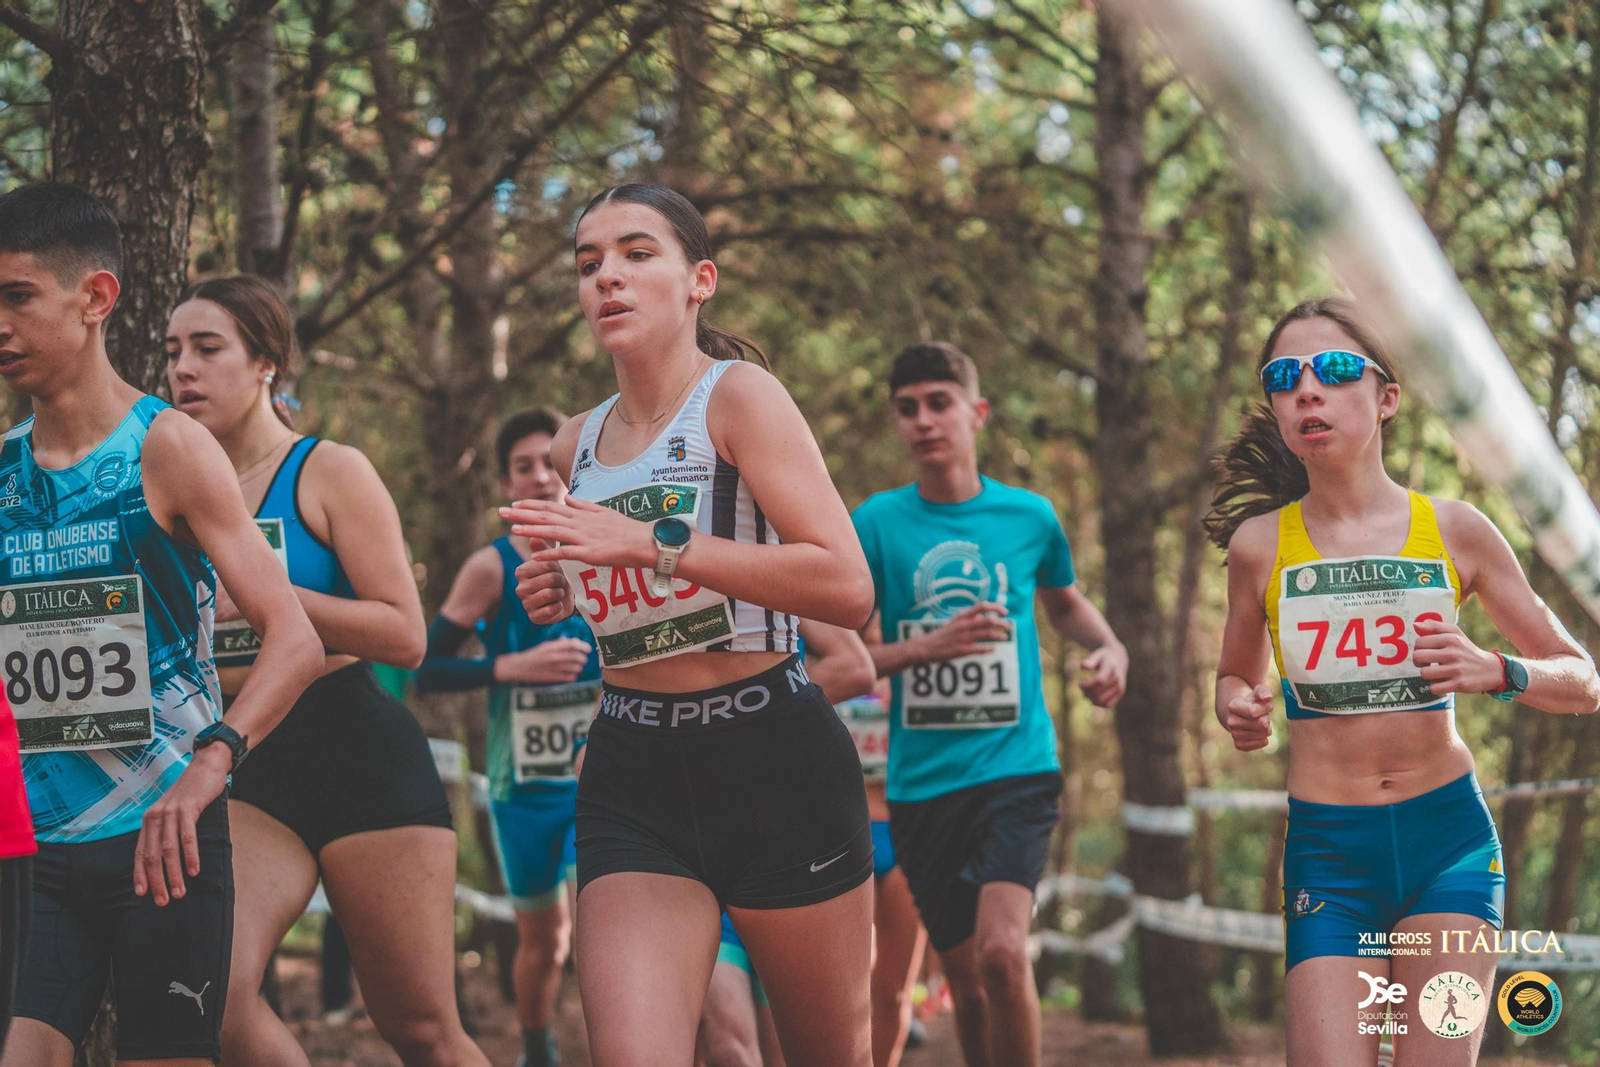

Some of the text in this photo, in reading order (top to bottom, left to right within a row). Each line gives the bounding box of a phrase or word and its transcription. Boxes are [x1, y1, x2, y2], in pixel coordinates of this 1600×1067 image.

[651, 464, 708, 477] Ayuntamiento
[662, 474, 709, 483] Salamanca
[5, 521, 118, 555] CLUB ONUBENSE
[12, 544, 110, 576] DE ATLETISMO
[1328, 562, 1407, 584] ITÁLICA
[25, 588, 93, 610] ITÁLICA
[579, 566, 700, 623] 540
[1333, 593, 1355, 601] SONIA
[1383, 590, 1406, 598] PEREZ
[19, 622, 45, 631] MANUEL
[70, 617, 105, 626] ROMERO
[5, 642, 136, 705] 8093
[911, 660, 1009, 697] 8091
[601, 690, 663, 726] NIKE
[670, 685, 771, 727] PRO
